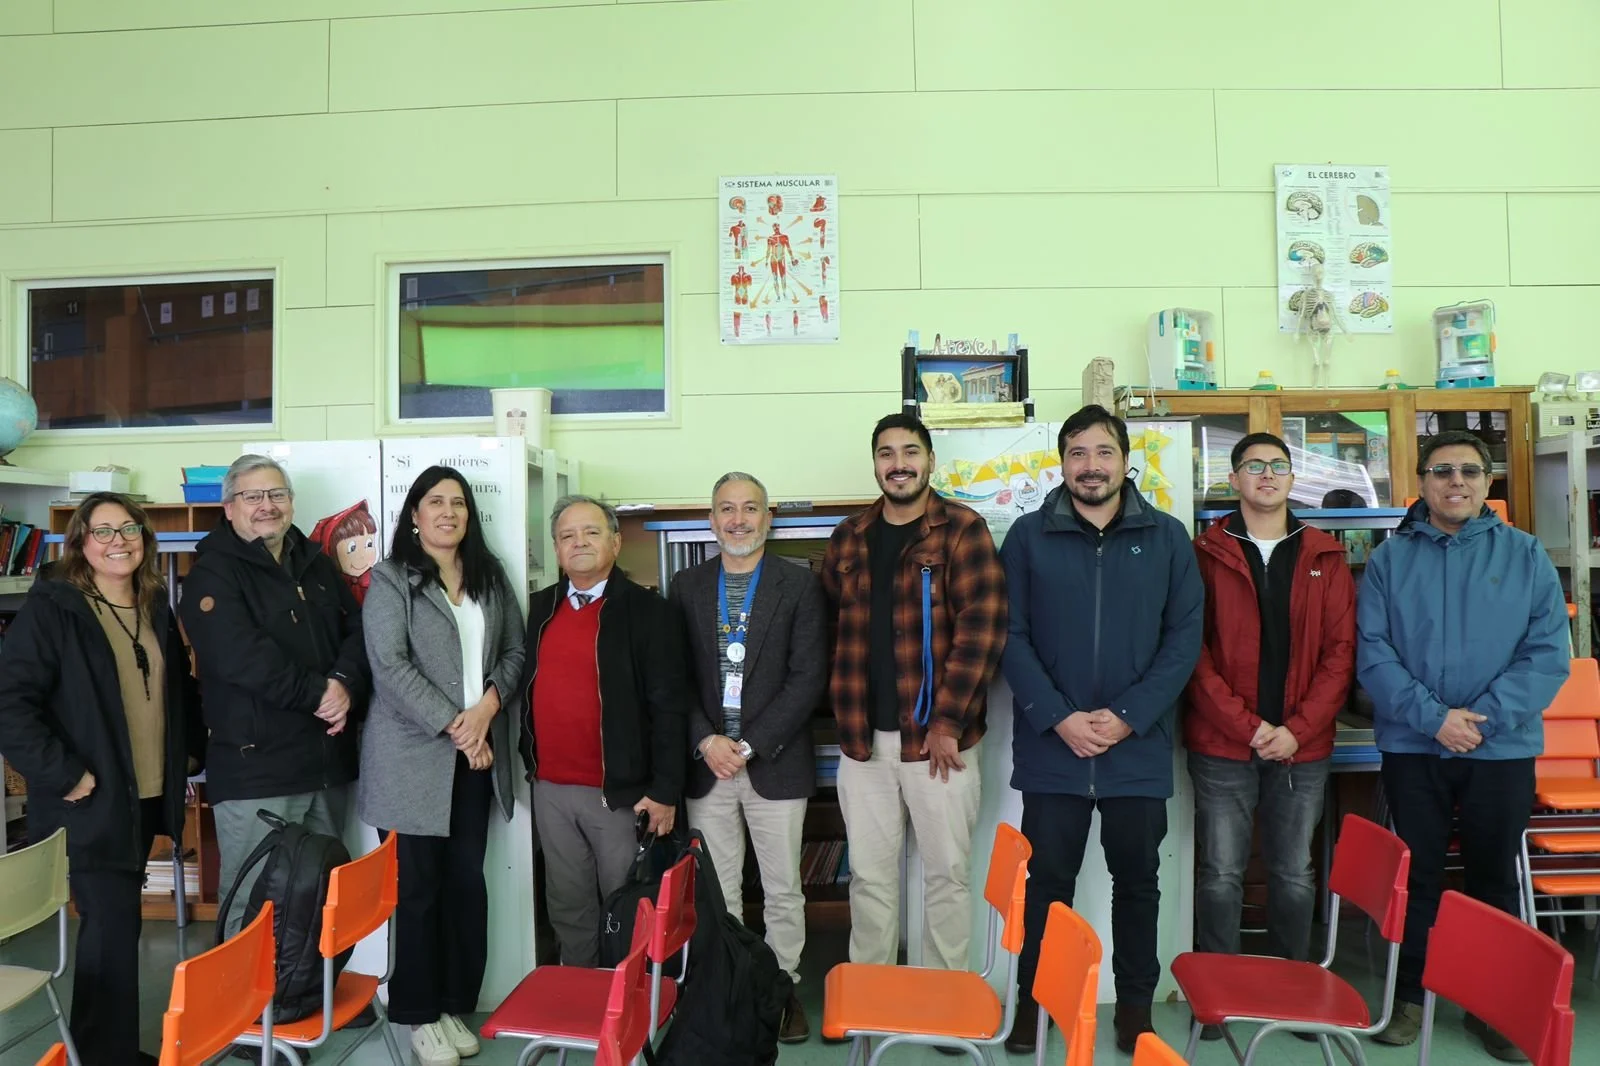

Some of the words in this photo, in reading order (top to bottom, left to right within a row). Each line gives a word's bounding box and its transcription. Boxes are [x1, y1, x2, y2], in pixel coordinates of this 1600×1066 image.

[1308, 171, 1317, 179] EL
[1319, 171, 1356, 179] CEREBRO
[737, 180, 772, 188] SISTEMA
[776, 179, 820, 188] MUSCULAR
[67, 301, 78, 314] 11
[397, 455, 410, 467] Si
[440, 454, 489, 469] quieres
[391, 484, 411, 494] un
